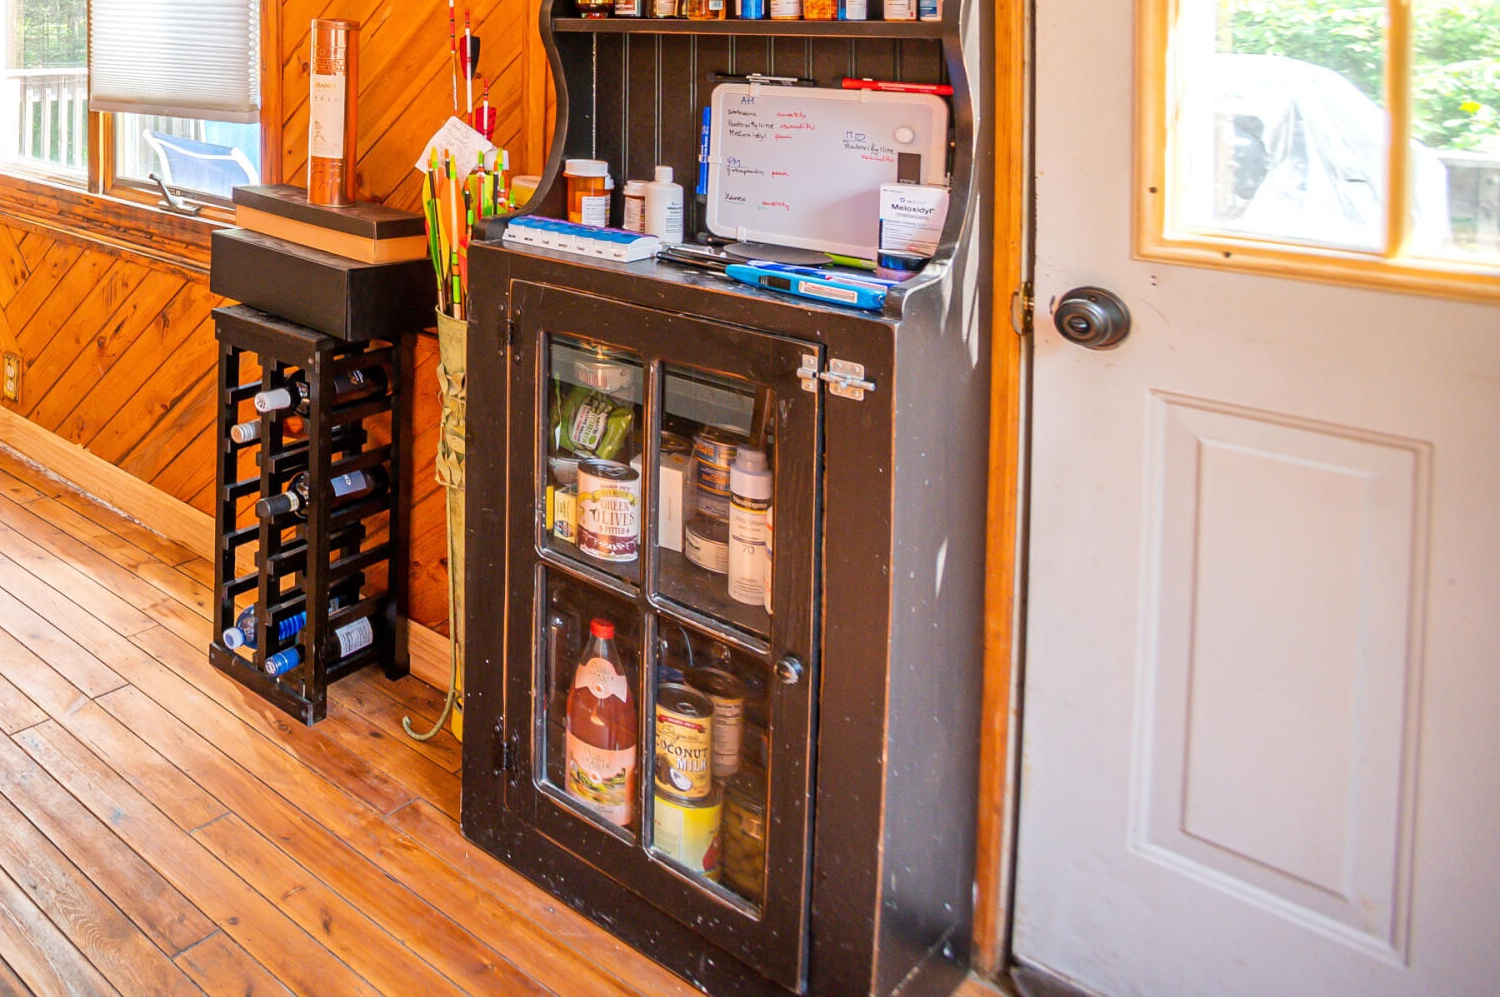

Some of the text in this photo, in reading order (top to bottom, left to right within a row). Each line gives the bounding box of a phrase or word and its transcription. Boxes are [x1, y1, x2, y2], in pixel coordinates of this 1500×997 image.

[740, 96, 755, 105] AM
[593, 509, 635, 527] OLIVES
[741, 545, 755, 555] 70
[676, 758, 708, 773] MILK
